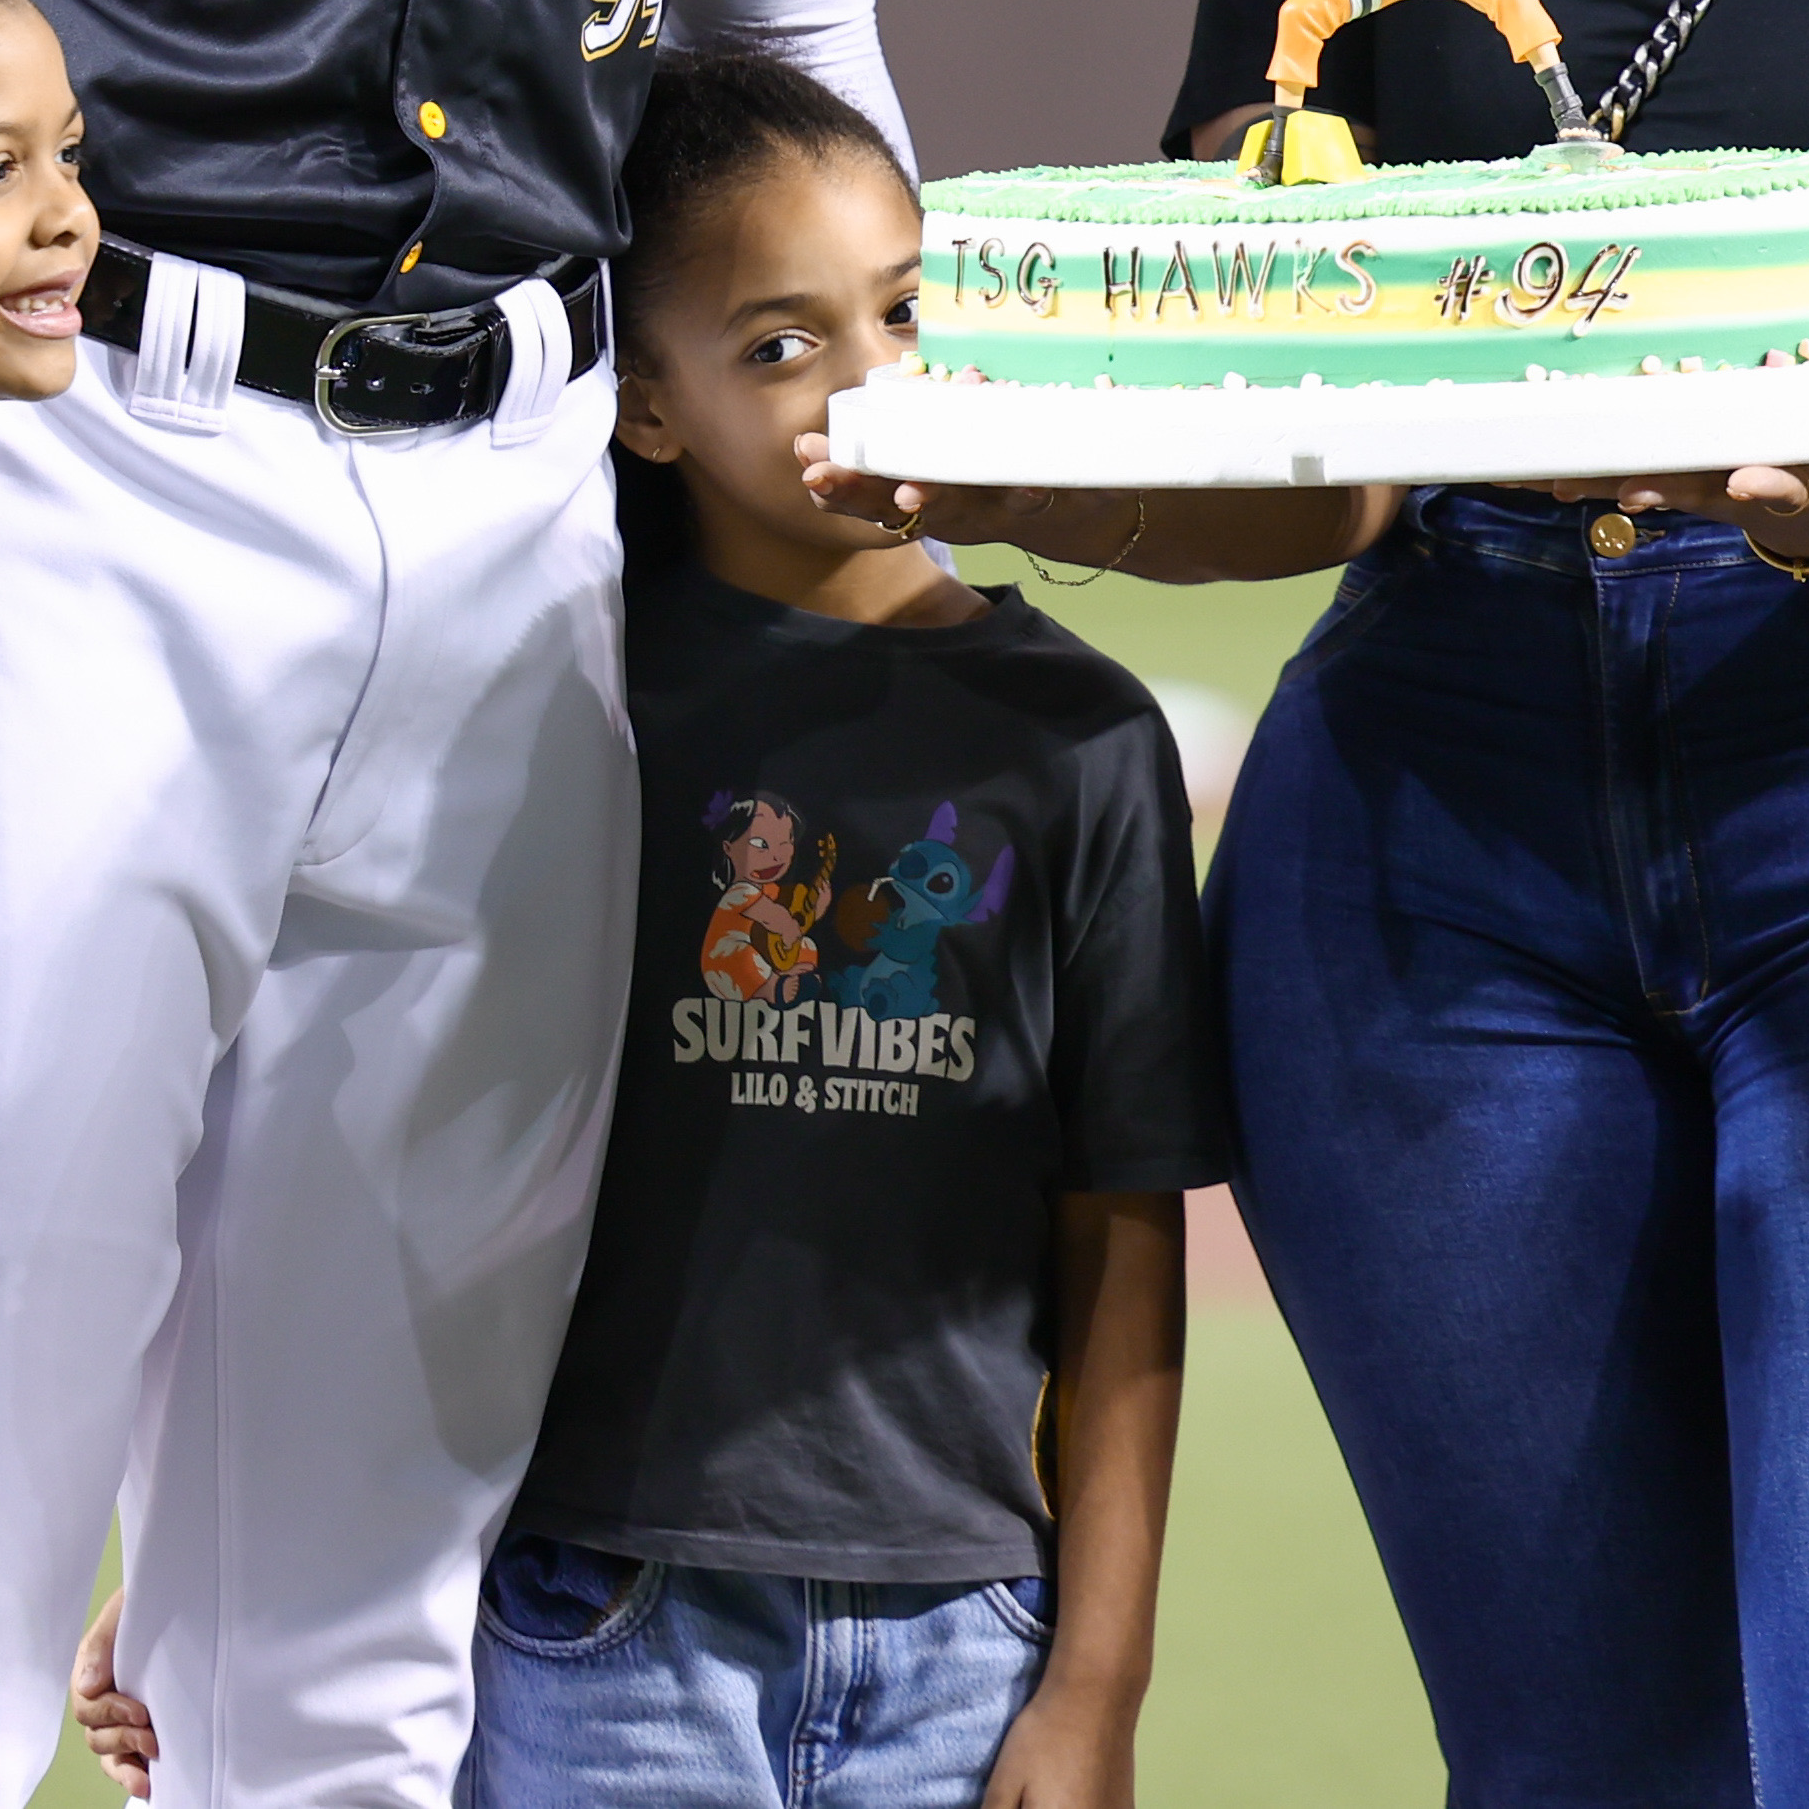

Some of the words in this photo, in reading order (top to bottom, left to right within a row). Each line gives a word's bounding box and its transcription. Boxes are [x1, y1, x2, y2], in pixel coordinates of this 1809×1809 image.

[951, 237, 1062, 318] TSG
[1101, 236, 1380, 321] HAWKS
[1431, 239, 1646, 340] #94
[671, 996, 816, 1064] SURF
[819, 1000, 977, 1083] VIBES
[730, 1071, 788, 1107] LILO
[794, 1077, 819, 1114] &
[823, 1077, 920, 1117] STITCH
